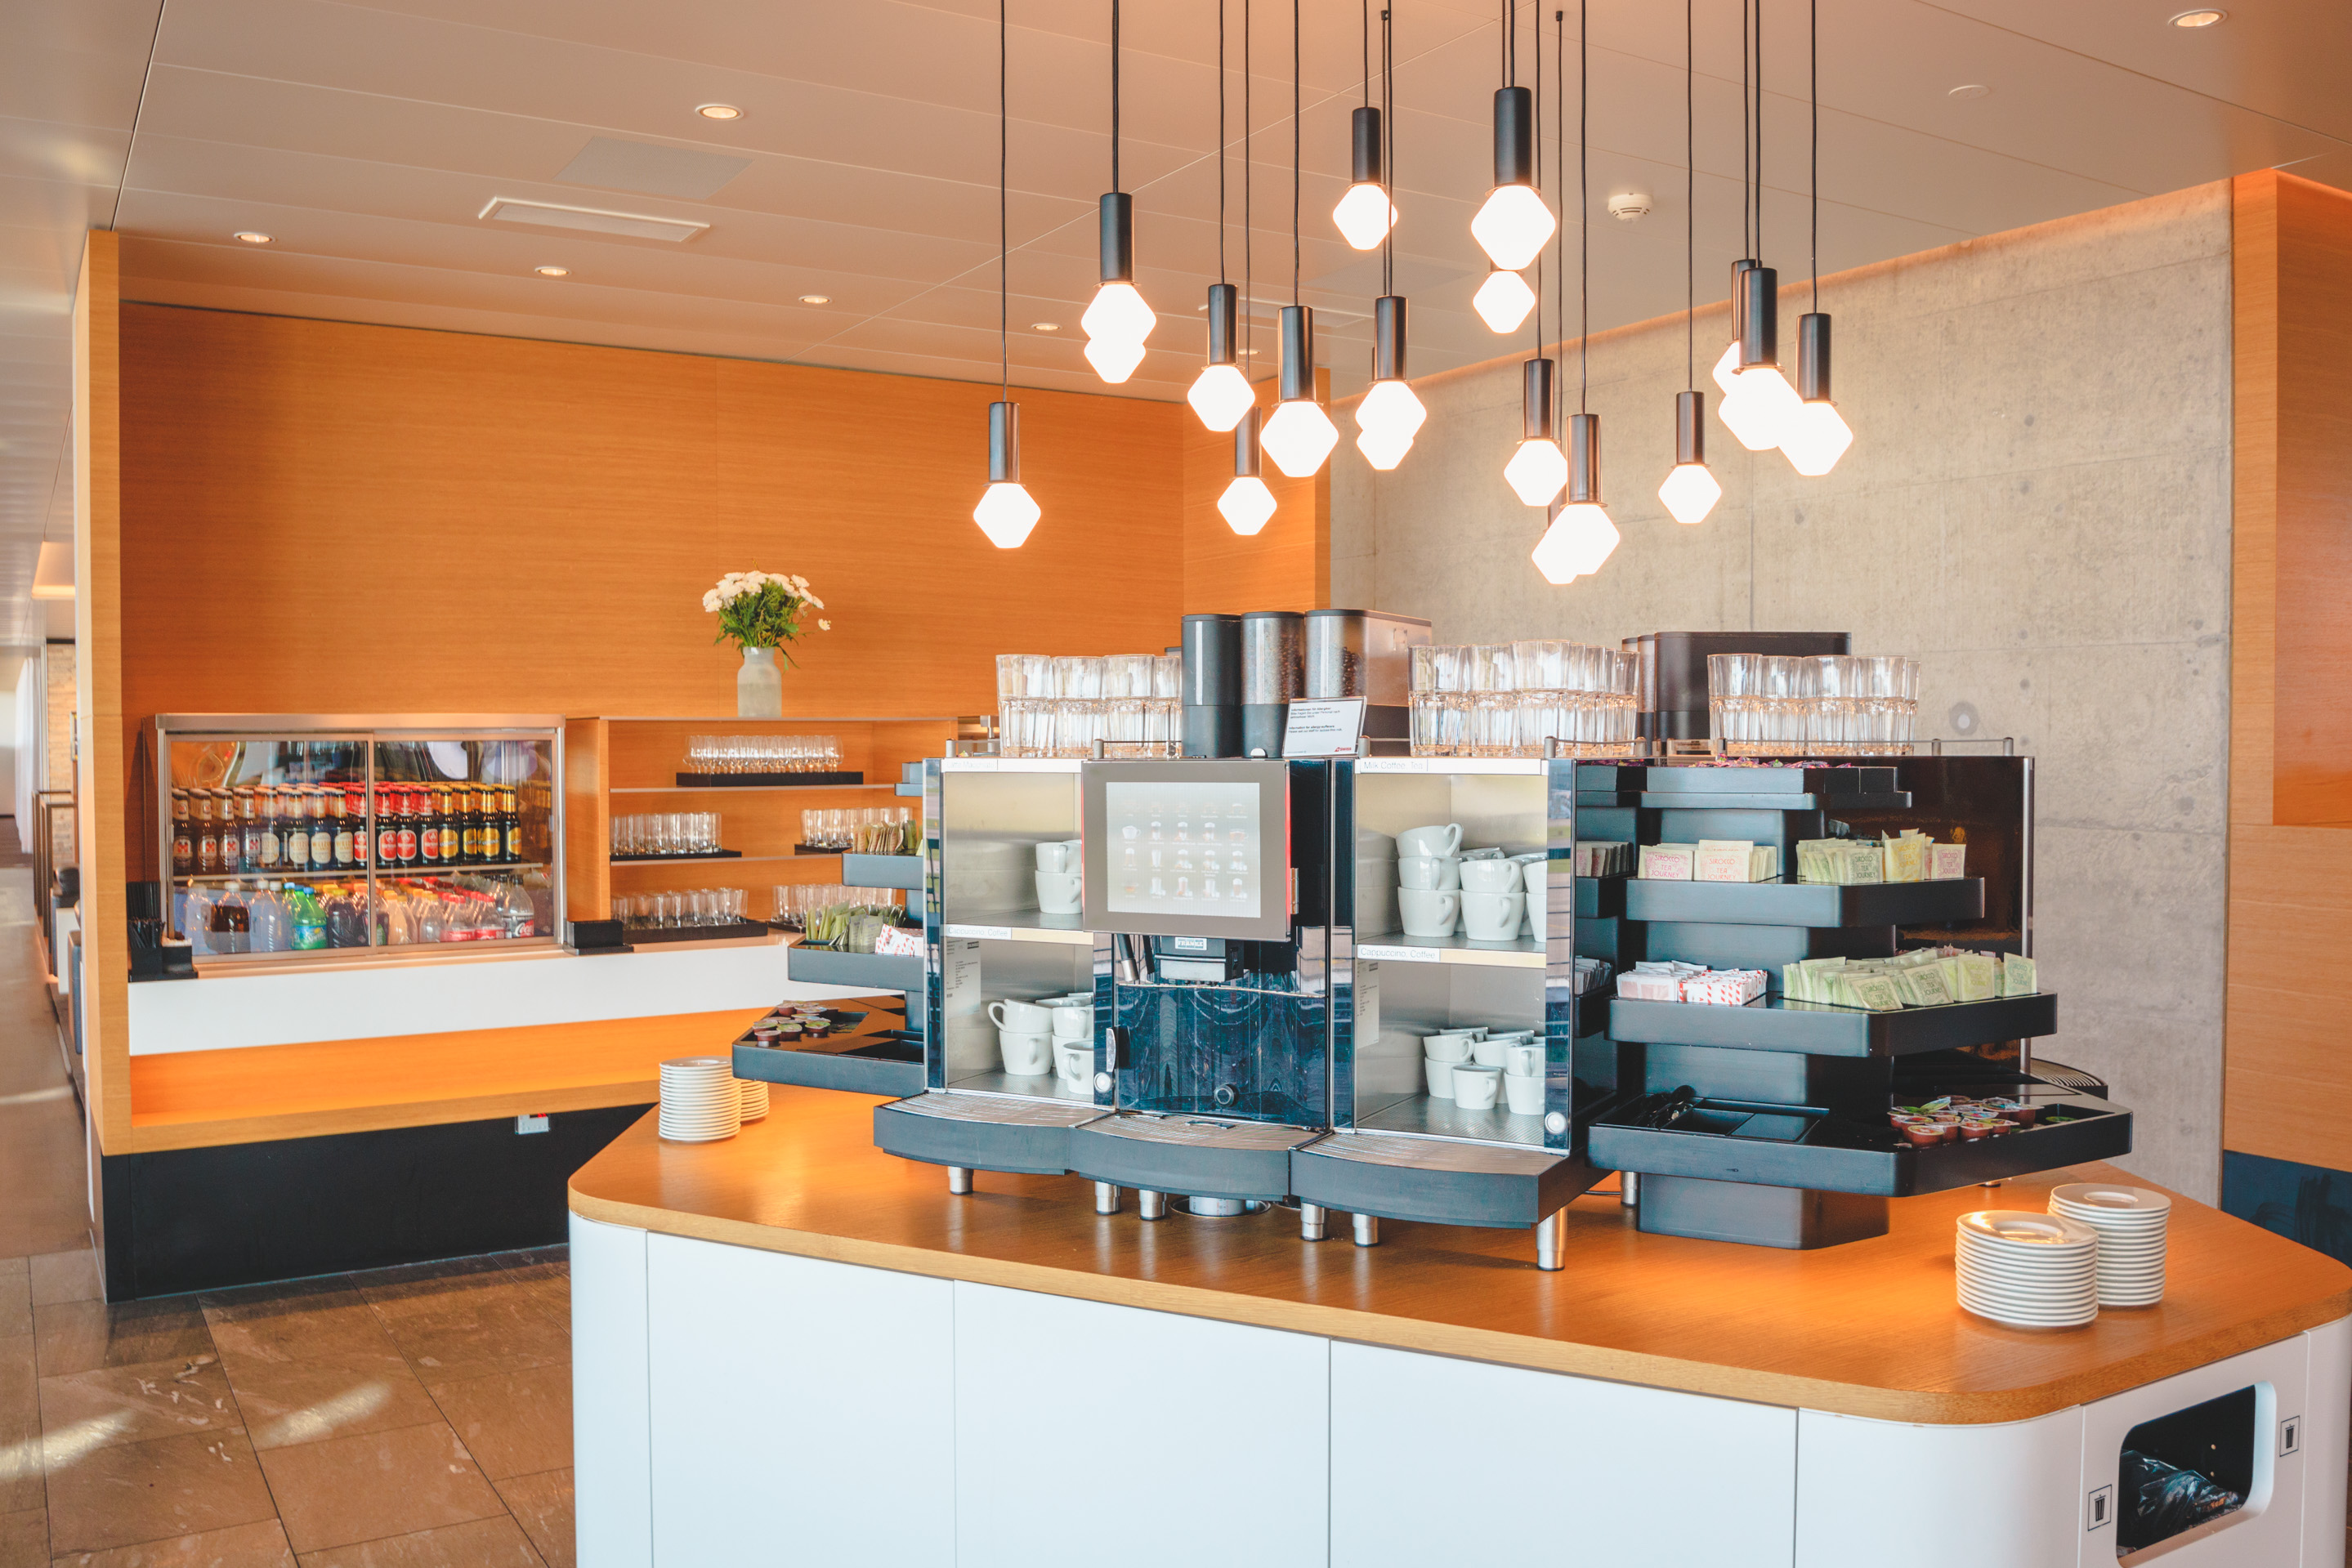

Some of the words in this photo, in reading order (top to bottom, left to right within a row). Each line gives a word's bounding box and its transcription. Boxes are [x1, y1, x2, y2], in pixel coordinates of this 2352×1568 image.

[1411, 762, 1423, 770] Tea
[1654, 854, 1680, 863] SIROCCO
[1651, 869, 1679, 878] JOURNEY
[987, 928, 1008, 937] Coffee
[1410, 949, 1435, 958] Coffee
[1924, 988, 1943, 996] JOURNEY
